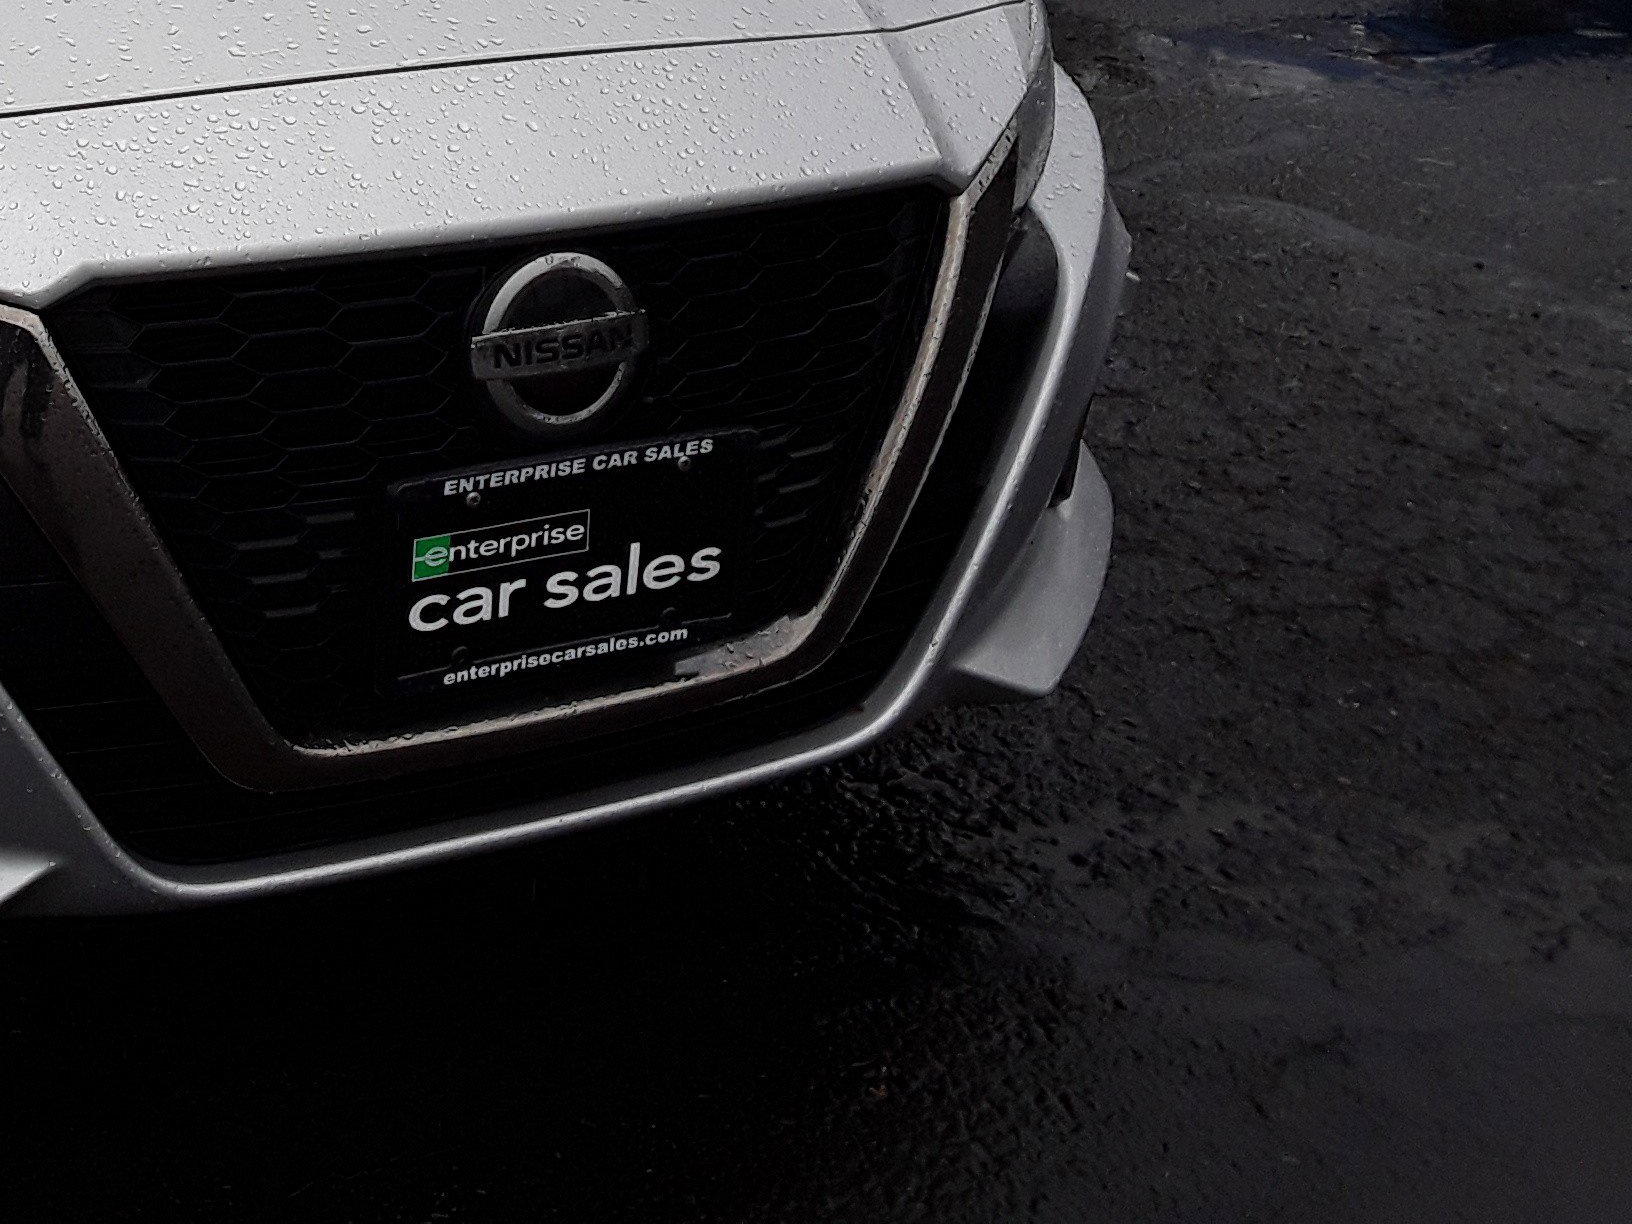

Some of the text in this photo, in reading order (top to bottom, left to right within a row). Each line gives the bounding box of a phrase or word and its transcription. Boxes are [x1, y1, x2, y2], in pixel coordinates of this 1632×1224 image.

[492, 325, 633, 369] NISSAN
[443, 438, 714, 496] ENTERPRISE CAR SALES
[420, 523, 586, 567] enterprise
[408, 542, 723, 633] car sales
[443, 626, 688, 686] enterprisecarsales.com
